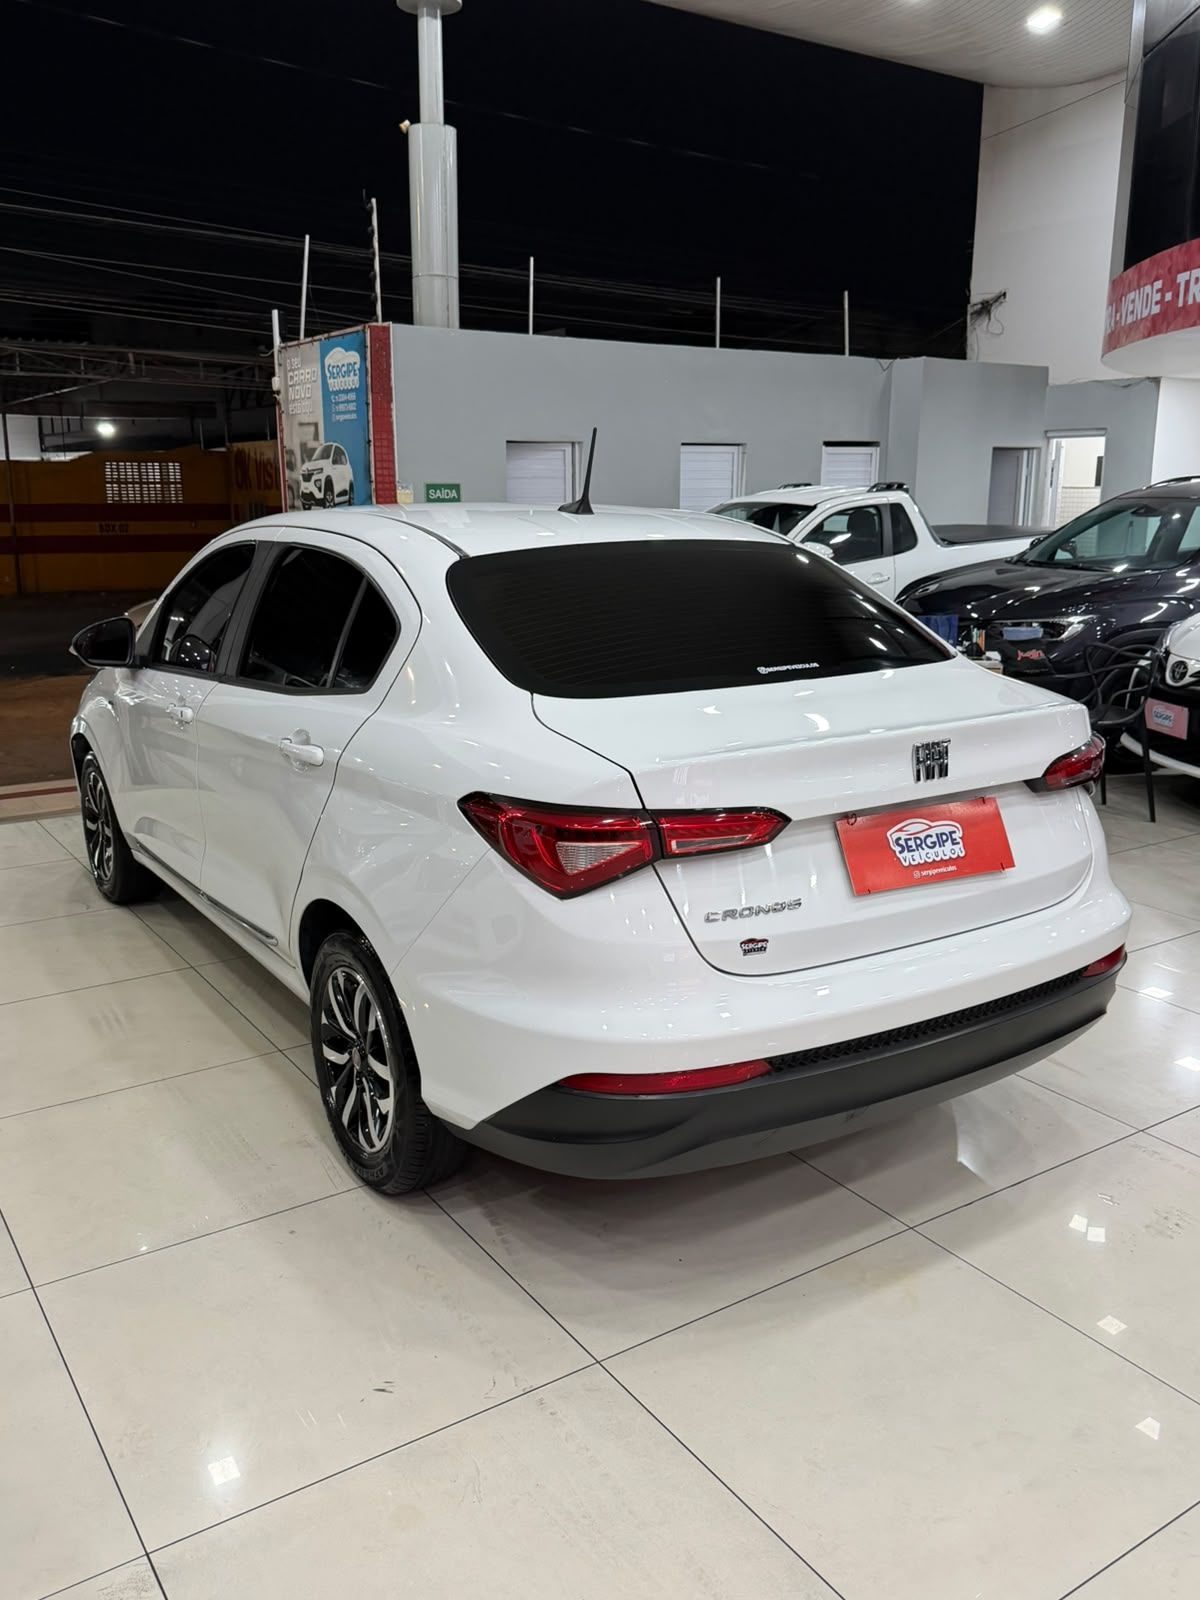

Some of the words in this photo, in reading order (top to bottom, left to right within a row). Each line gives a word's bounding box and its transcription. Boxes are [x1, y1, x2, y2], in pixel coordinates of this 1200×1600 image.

[1121, 279, 1162, 326] VENDE
[287, 367, 318, 385] CARRO
[327, 361, 359, 379] SERGIPE
[288, 384, 312, 400] NOVO
[428, 487, 458, 499] SAÍDA
[894, 830, 961, 855] SERGIPE
[704, 898, 802, 923] CRONOS
